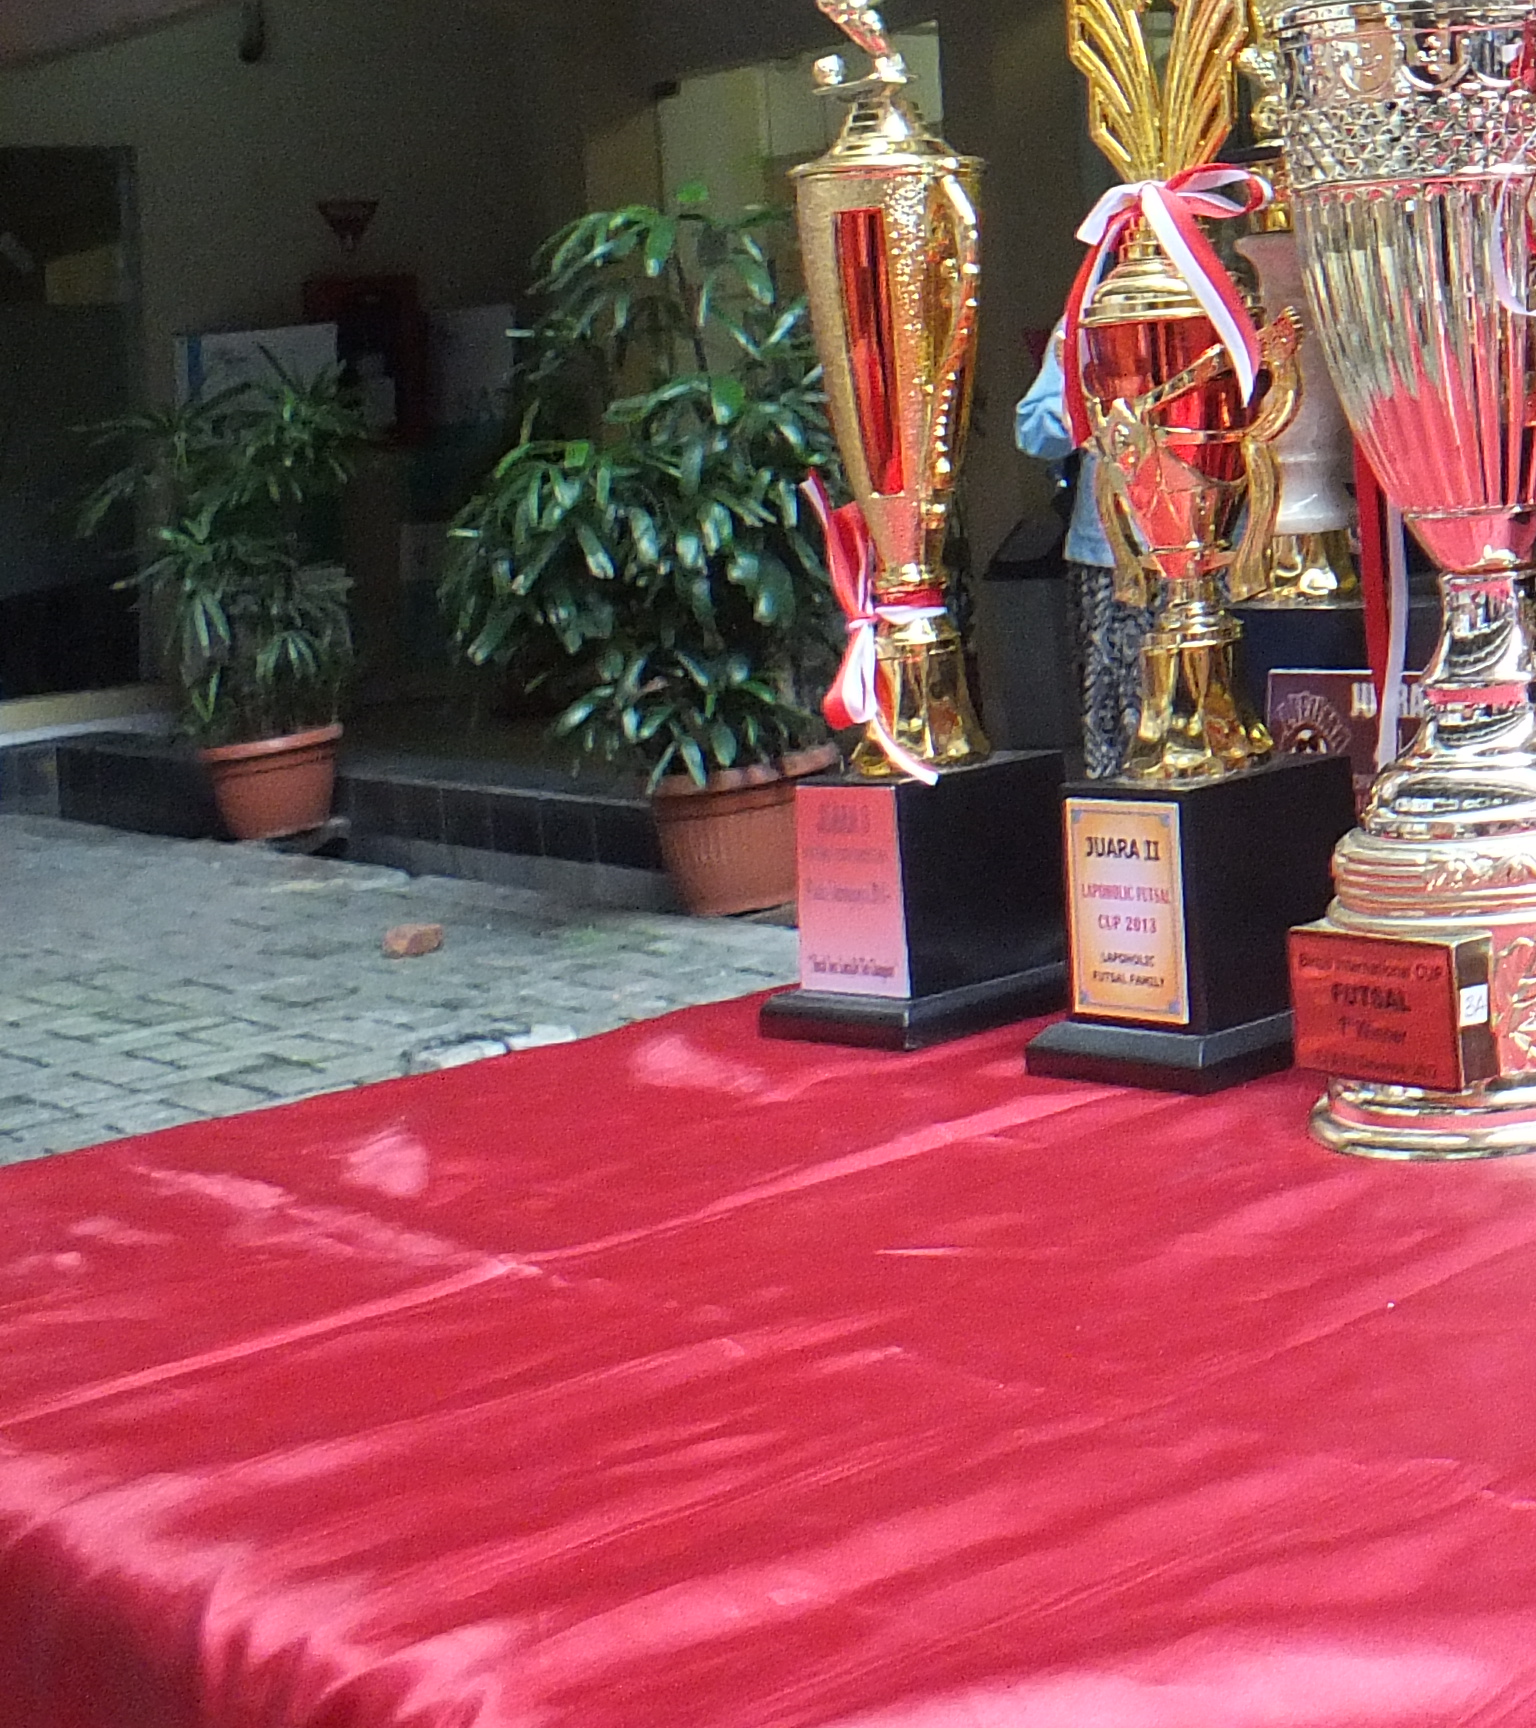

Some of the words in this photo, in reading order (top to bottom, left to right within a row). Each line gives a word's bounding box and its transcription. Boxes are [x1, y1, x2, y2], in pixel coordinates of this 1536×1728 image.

[1085, 836, 1140, 859] JUARA
[1143, 840, 1161, 862] II
[1097, 914, 1121, 930] CUP
